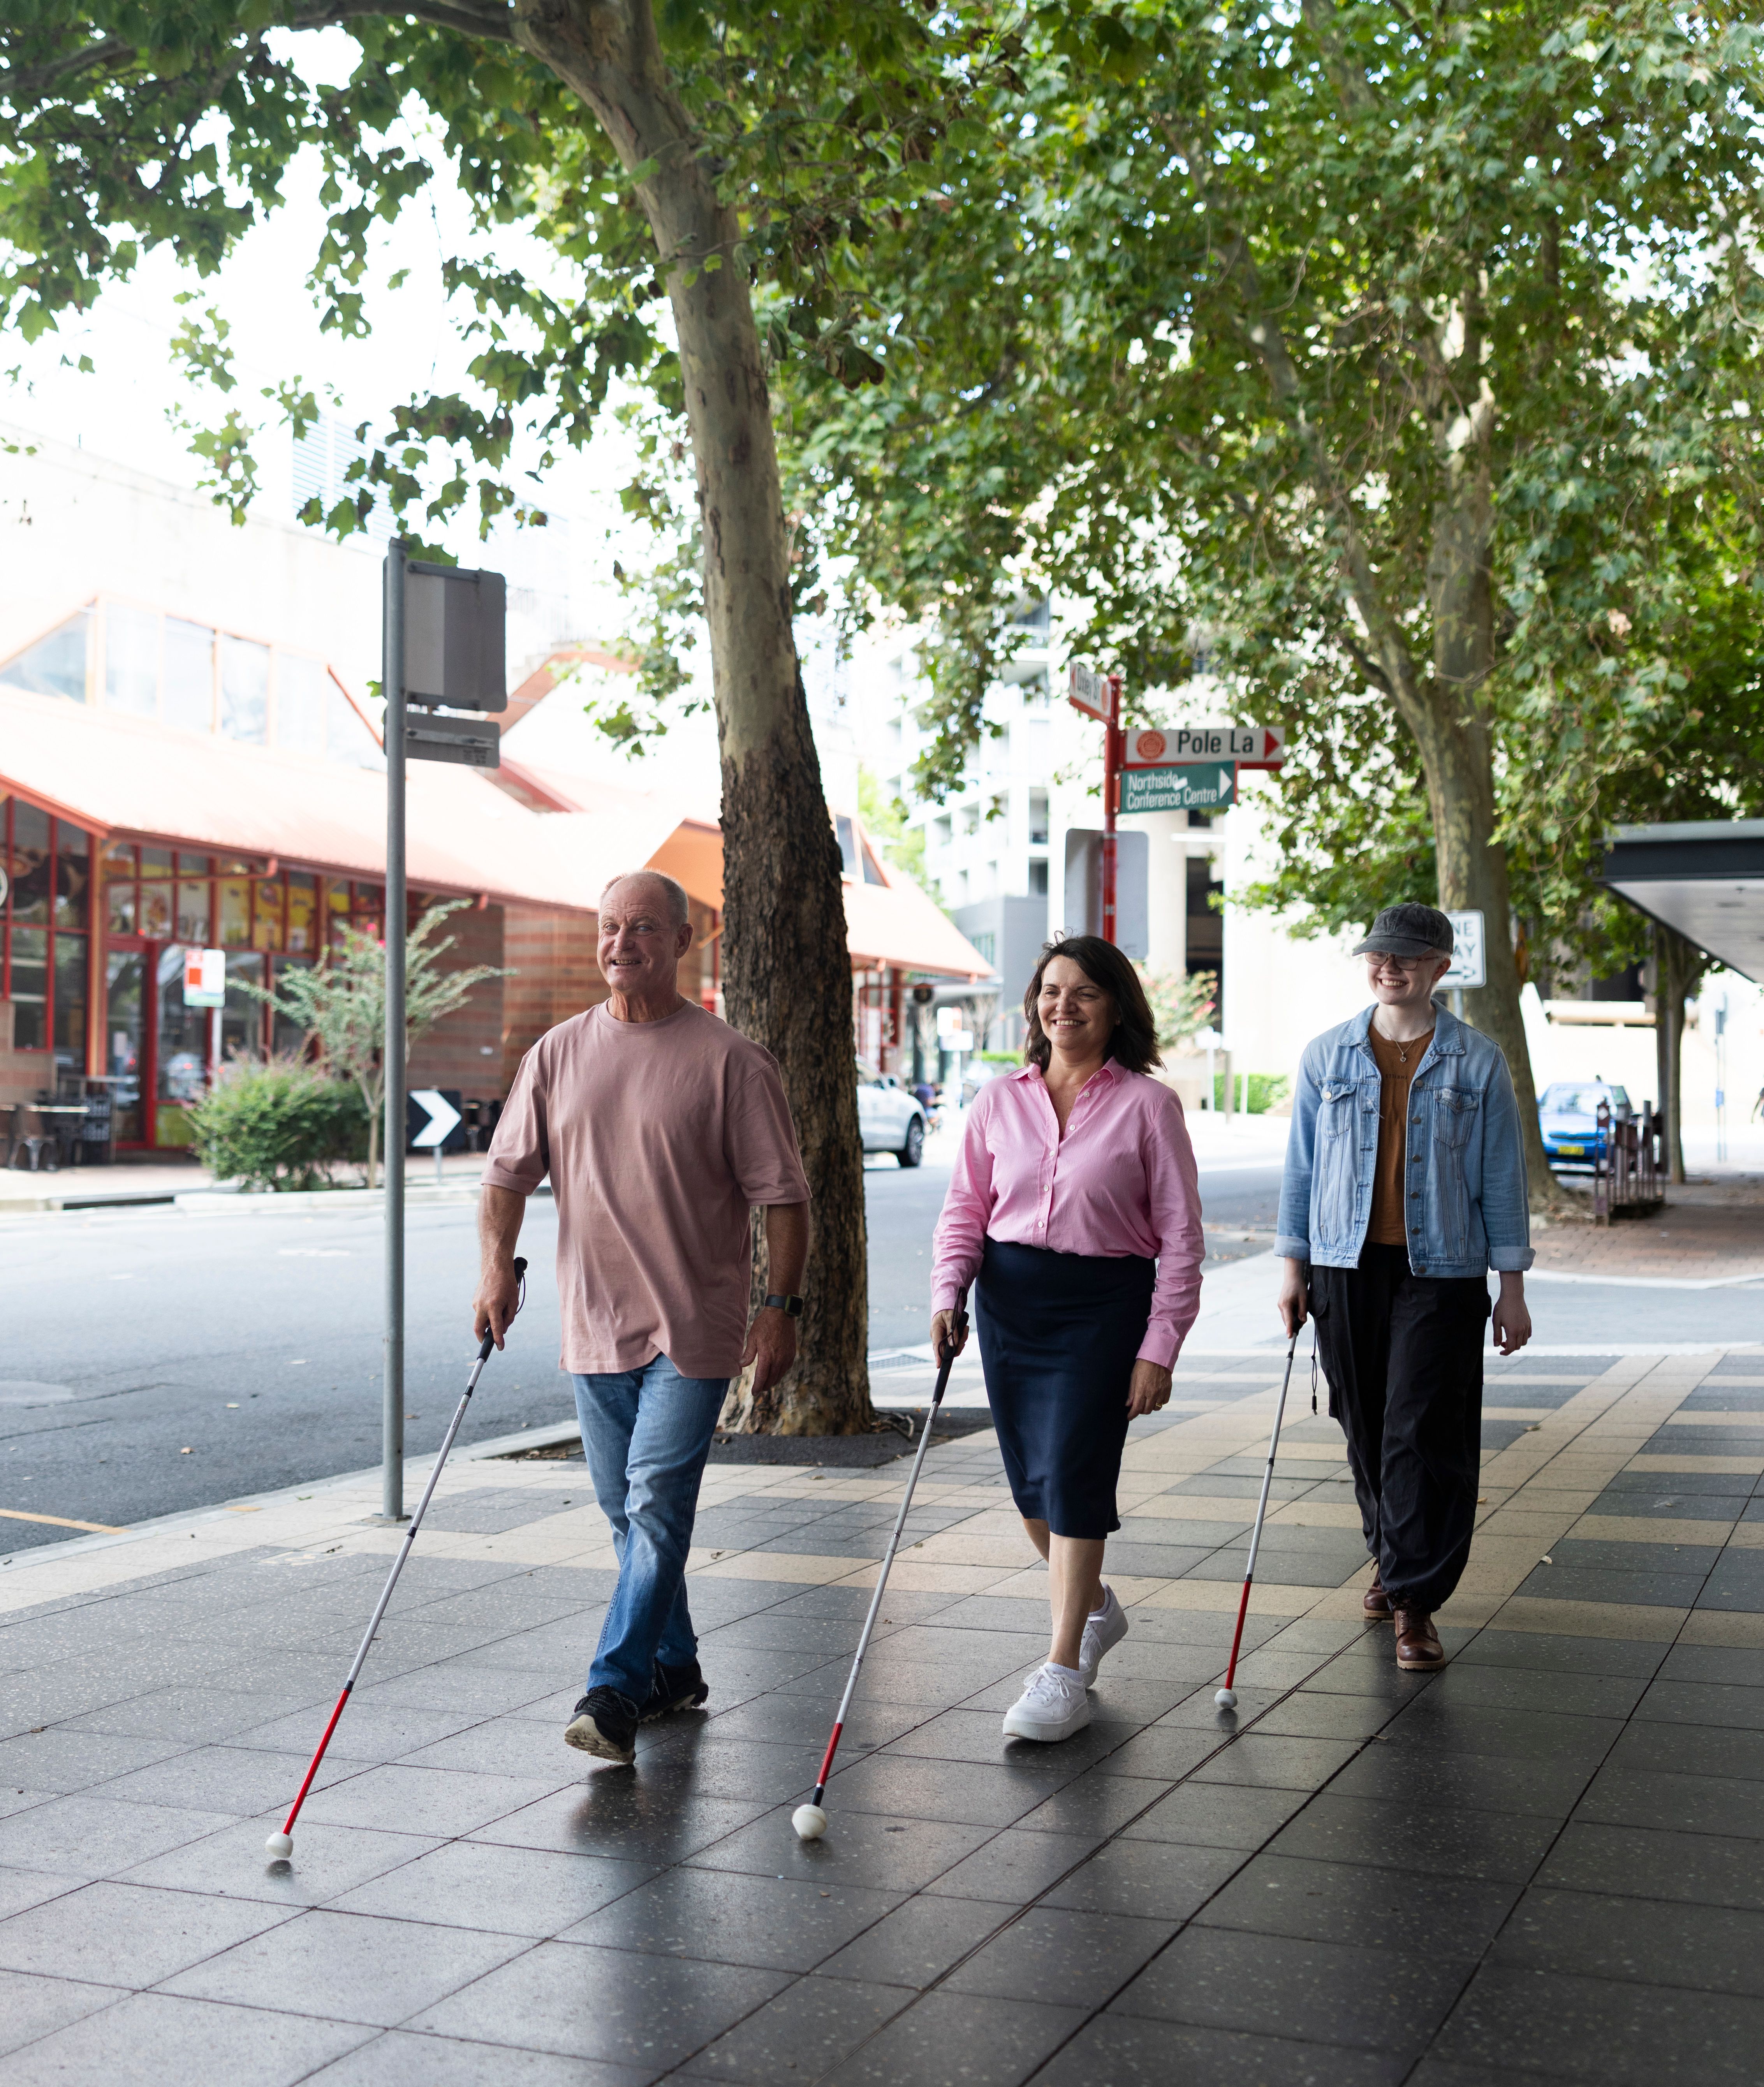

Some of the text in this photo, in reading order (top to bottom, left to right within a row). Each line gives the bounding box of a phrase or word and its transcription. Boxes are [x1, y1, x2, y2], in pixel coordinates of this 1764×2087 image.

[1178, 730, 1221, 754] Pole
[1231, 729, 1253, 753] La
[1128, 770, 1178, 791] Northside
[1127, 787, 1217, 810] Conference Centre
[1451, 921, 1473, 936] NE
[1452, 943, 1475, 959] AY
